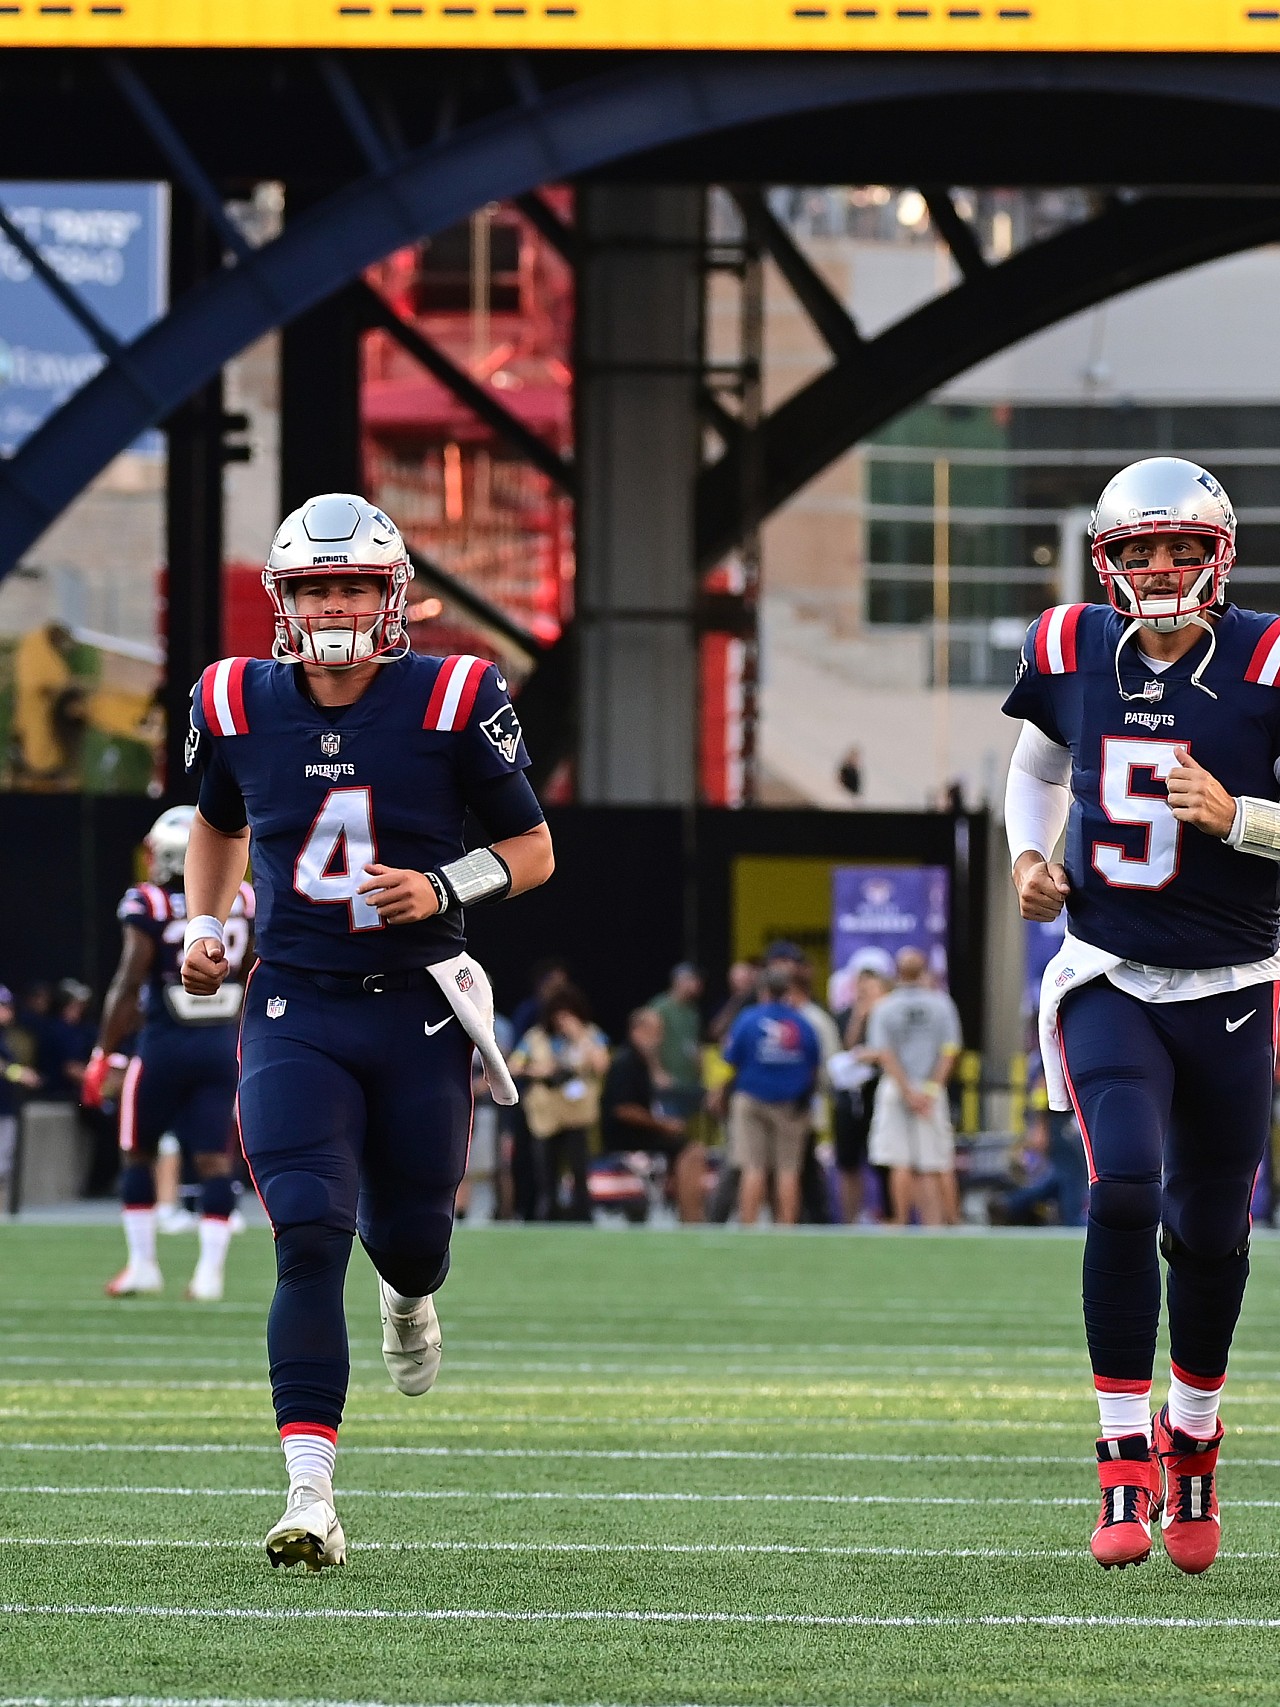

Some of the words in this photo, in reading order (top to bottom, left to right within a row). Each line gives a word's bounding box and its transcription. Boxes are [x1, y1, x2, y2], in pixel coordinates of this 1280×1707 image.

[1142, 509, 1168, 518] PATRIOTS
[312, 555, 348, 565] PATRIOTS
[1124, 712, 1175, 727] PATRIOTS
[305, 763, 355, 778] PATRIOTS
[1091, 735, 1192, 892] 5
[293, 785, 386, 934] 4
